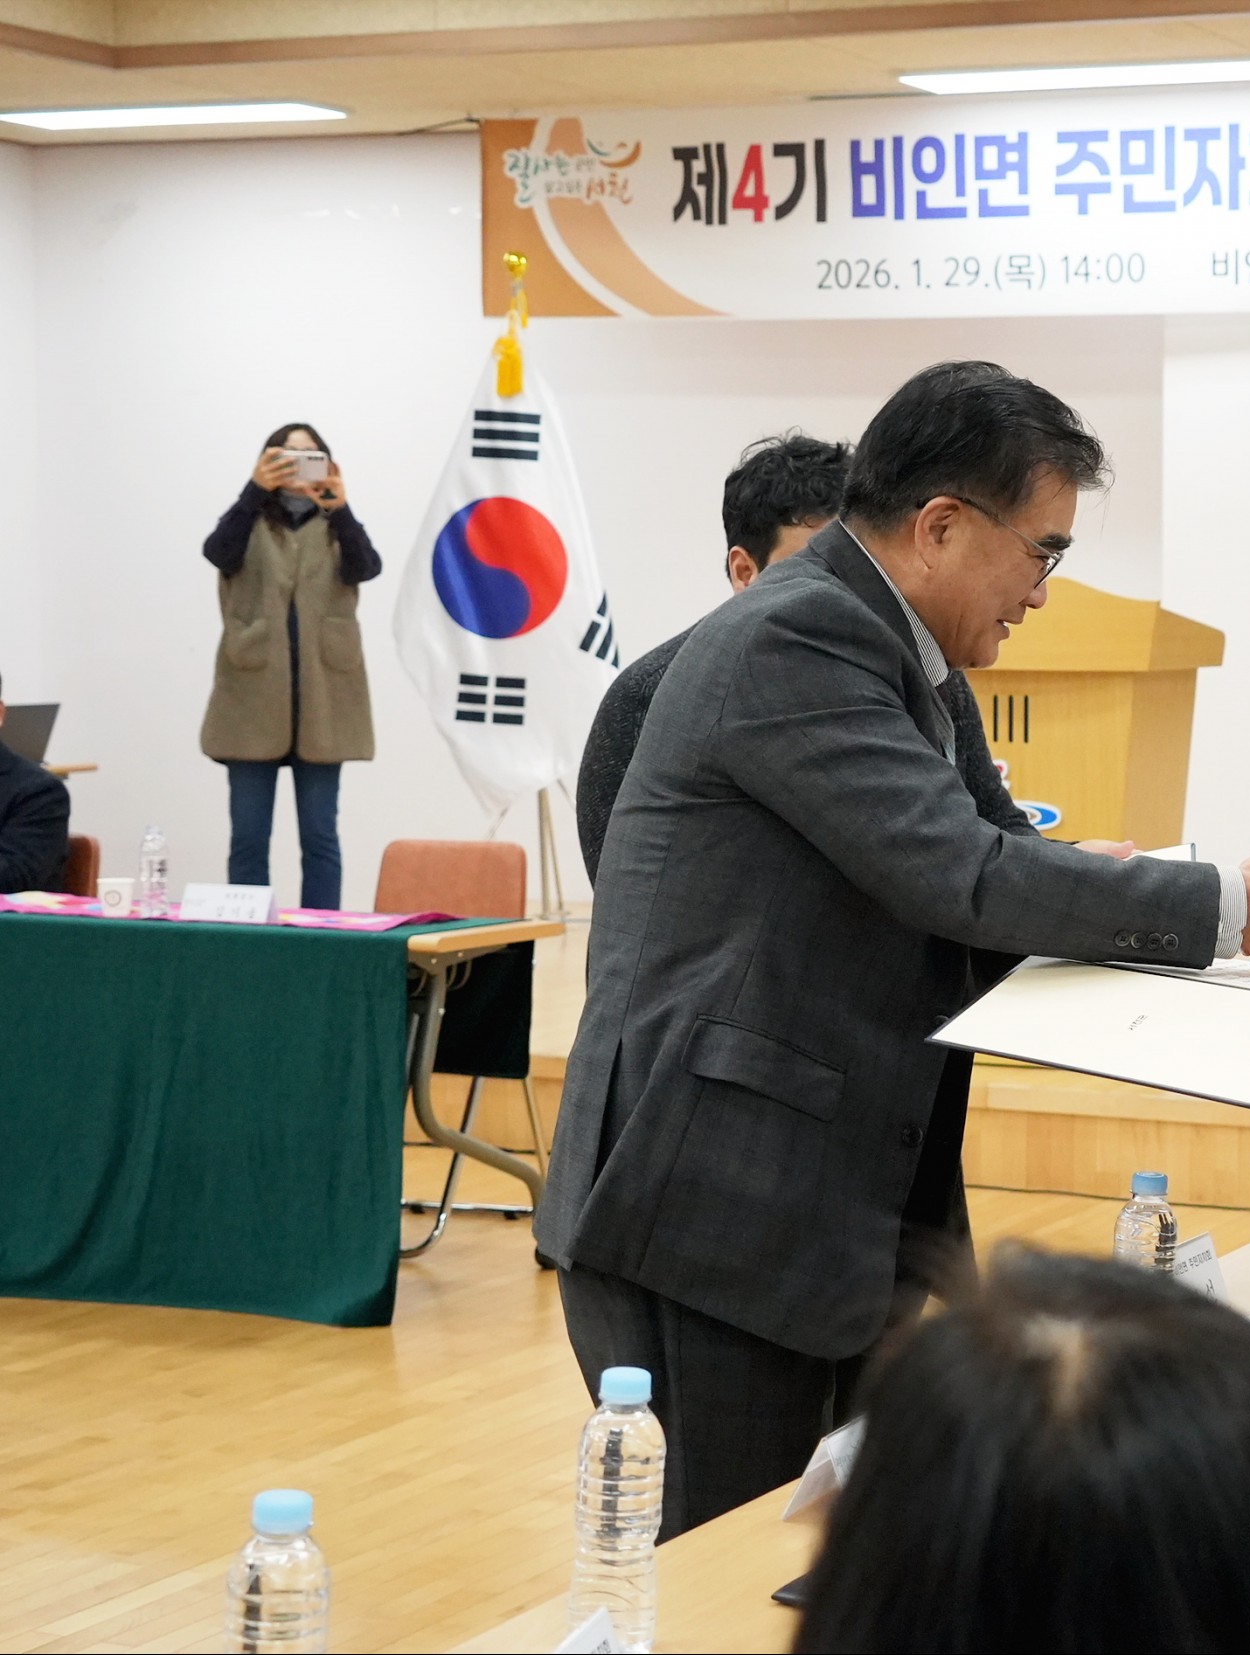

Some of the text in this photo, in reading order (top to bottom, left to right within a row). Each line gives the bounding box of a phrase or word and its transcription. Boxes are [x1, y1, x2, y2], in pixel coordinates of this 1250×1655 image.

[672, 139, 828, 226] 제4기
[850, 131, 1030, 221] 비인면
[816, 257, 900, 290] 2026.
[911, 257, 931, 290] 1.
[944, 253, 1047, 292] 29.(목)
[1060, 252, 1146, 284] 14:00
